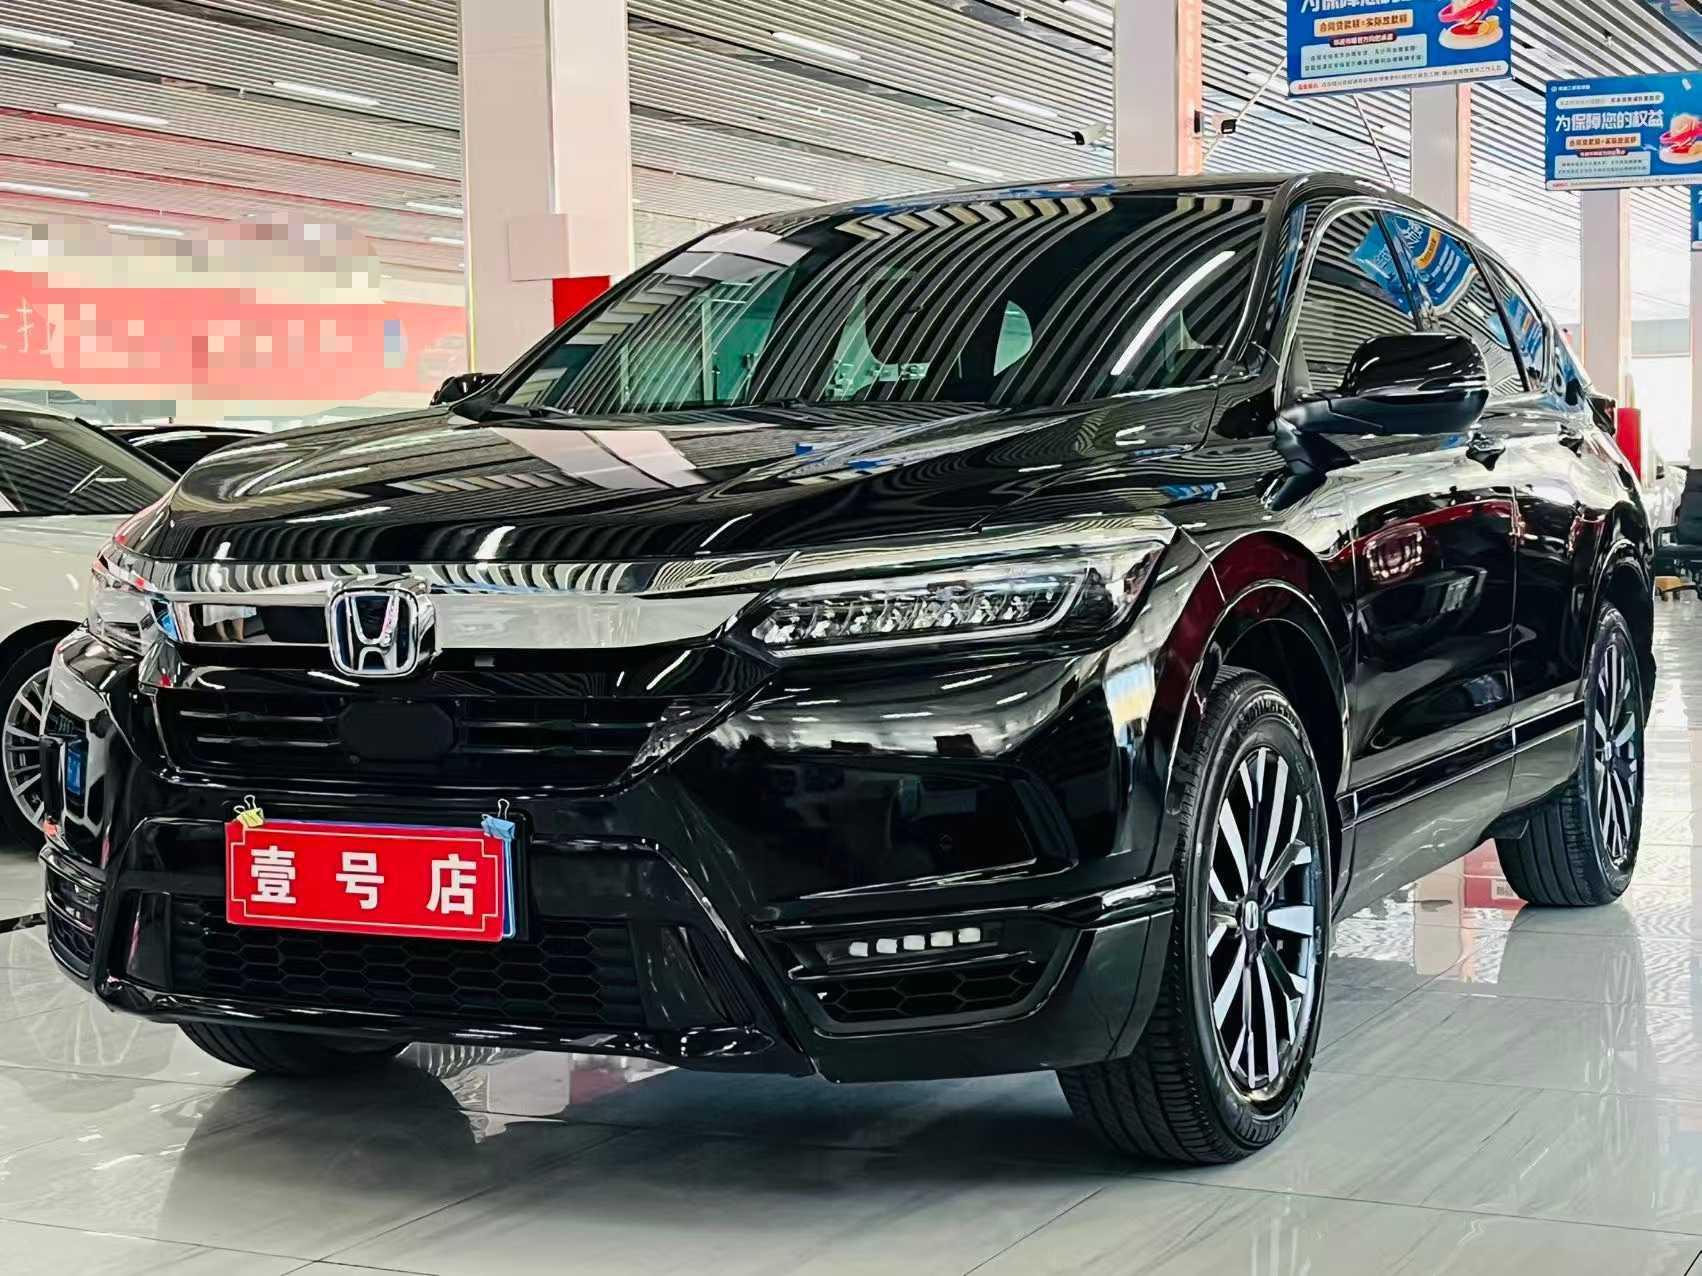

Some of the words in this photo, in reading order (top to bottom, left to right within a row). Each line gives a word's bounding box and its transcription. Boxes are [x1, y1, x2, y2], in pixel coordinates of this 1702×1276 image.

[1555, 109, 1664, 132] 为保障您的权益
[250, 845, 478, 915] 壹号店
